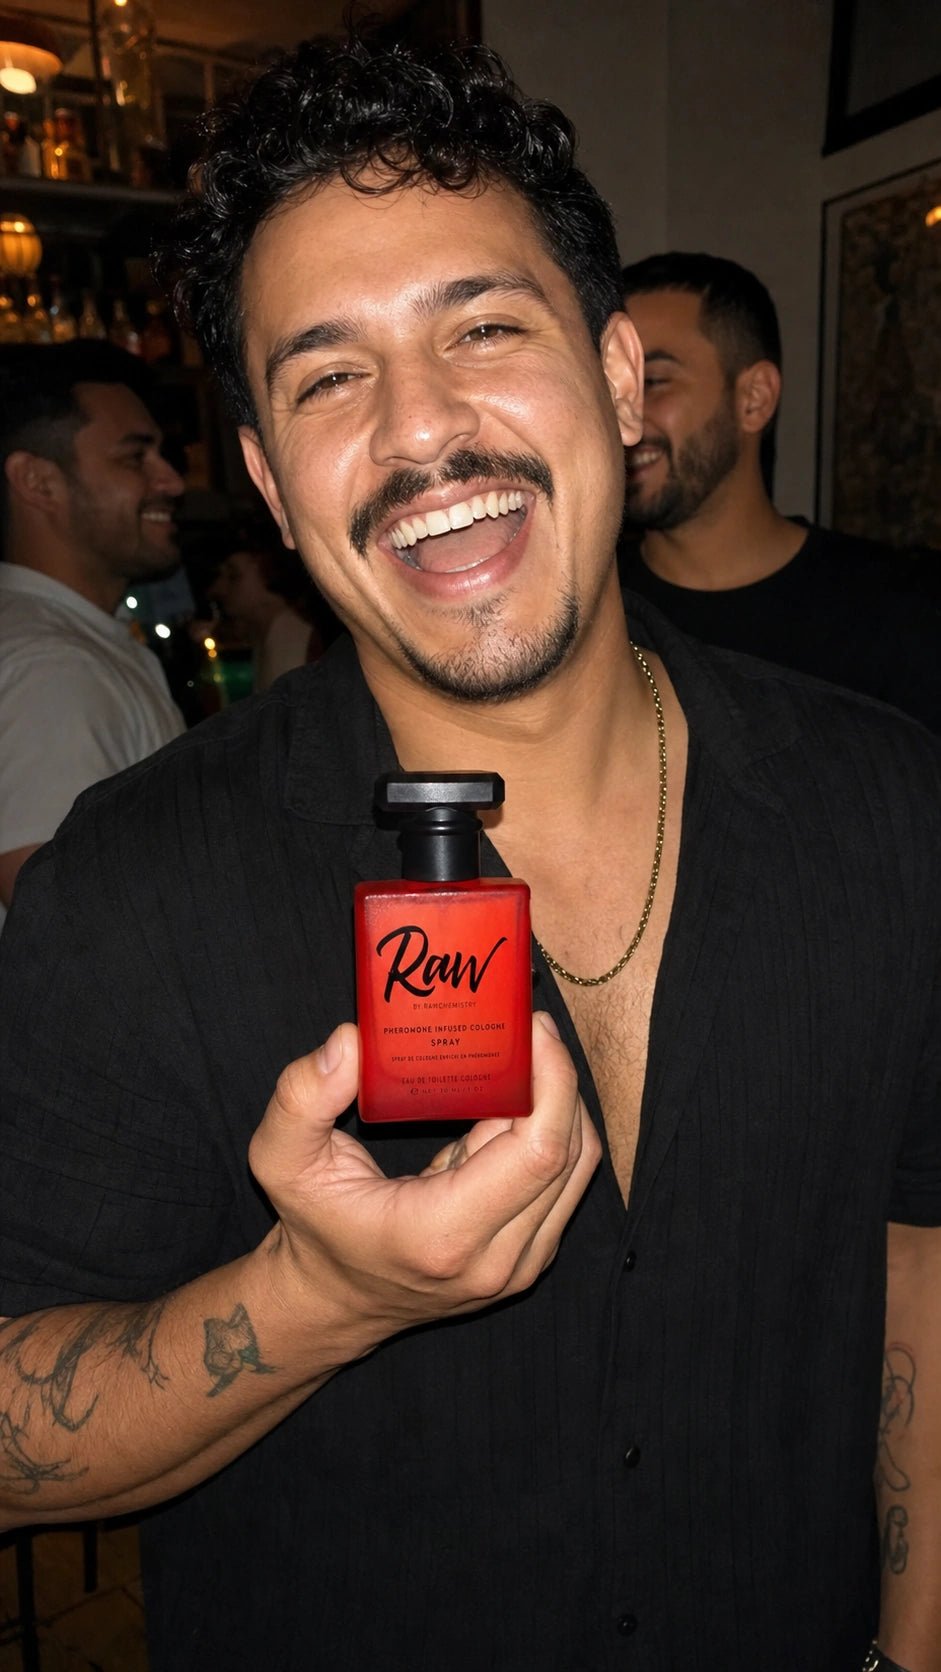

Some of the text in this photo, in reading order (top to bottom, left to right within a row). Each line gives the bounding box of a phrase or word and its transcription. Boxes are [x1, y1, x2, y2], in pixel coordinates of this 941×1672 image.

[376, 925, 508, 1003] Raw
[383, 1026, 432, 1034] PHEROMONE
[435, 1024, 467, 1032] INFUSED
[431, 1038, 460, 1047] SPRAY
[401, 1073, 491, 1085] EAU DE TOILETTE COLOGNE
